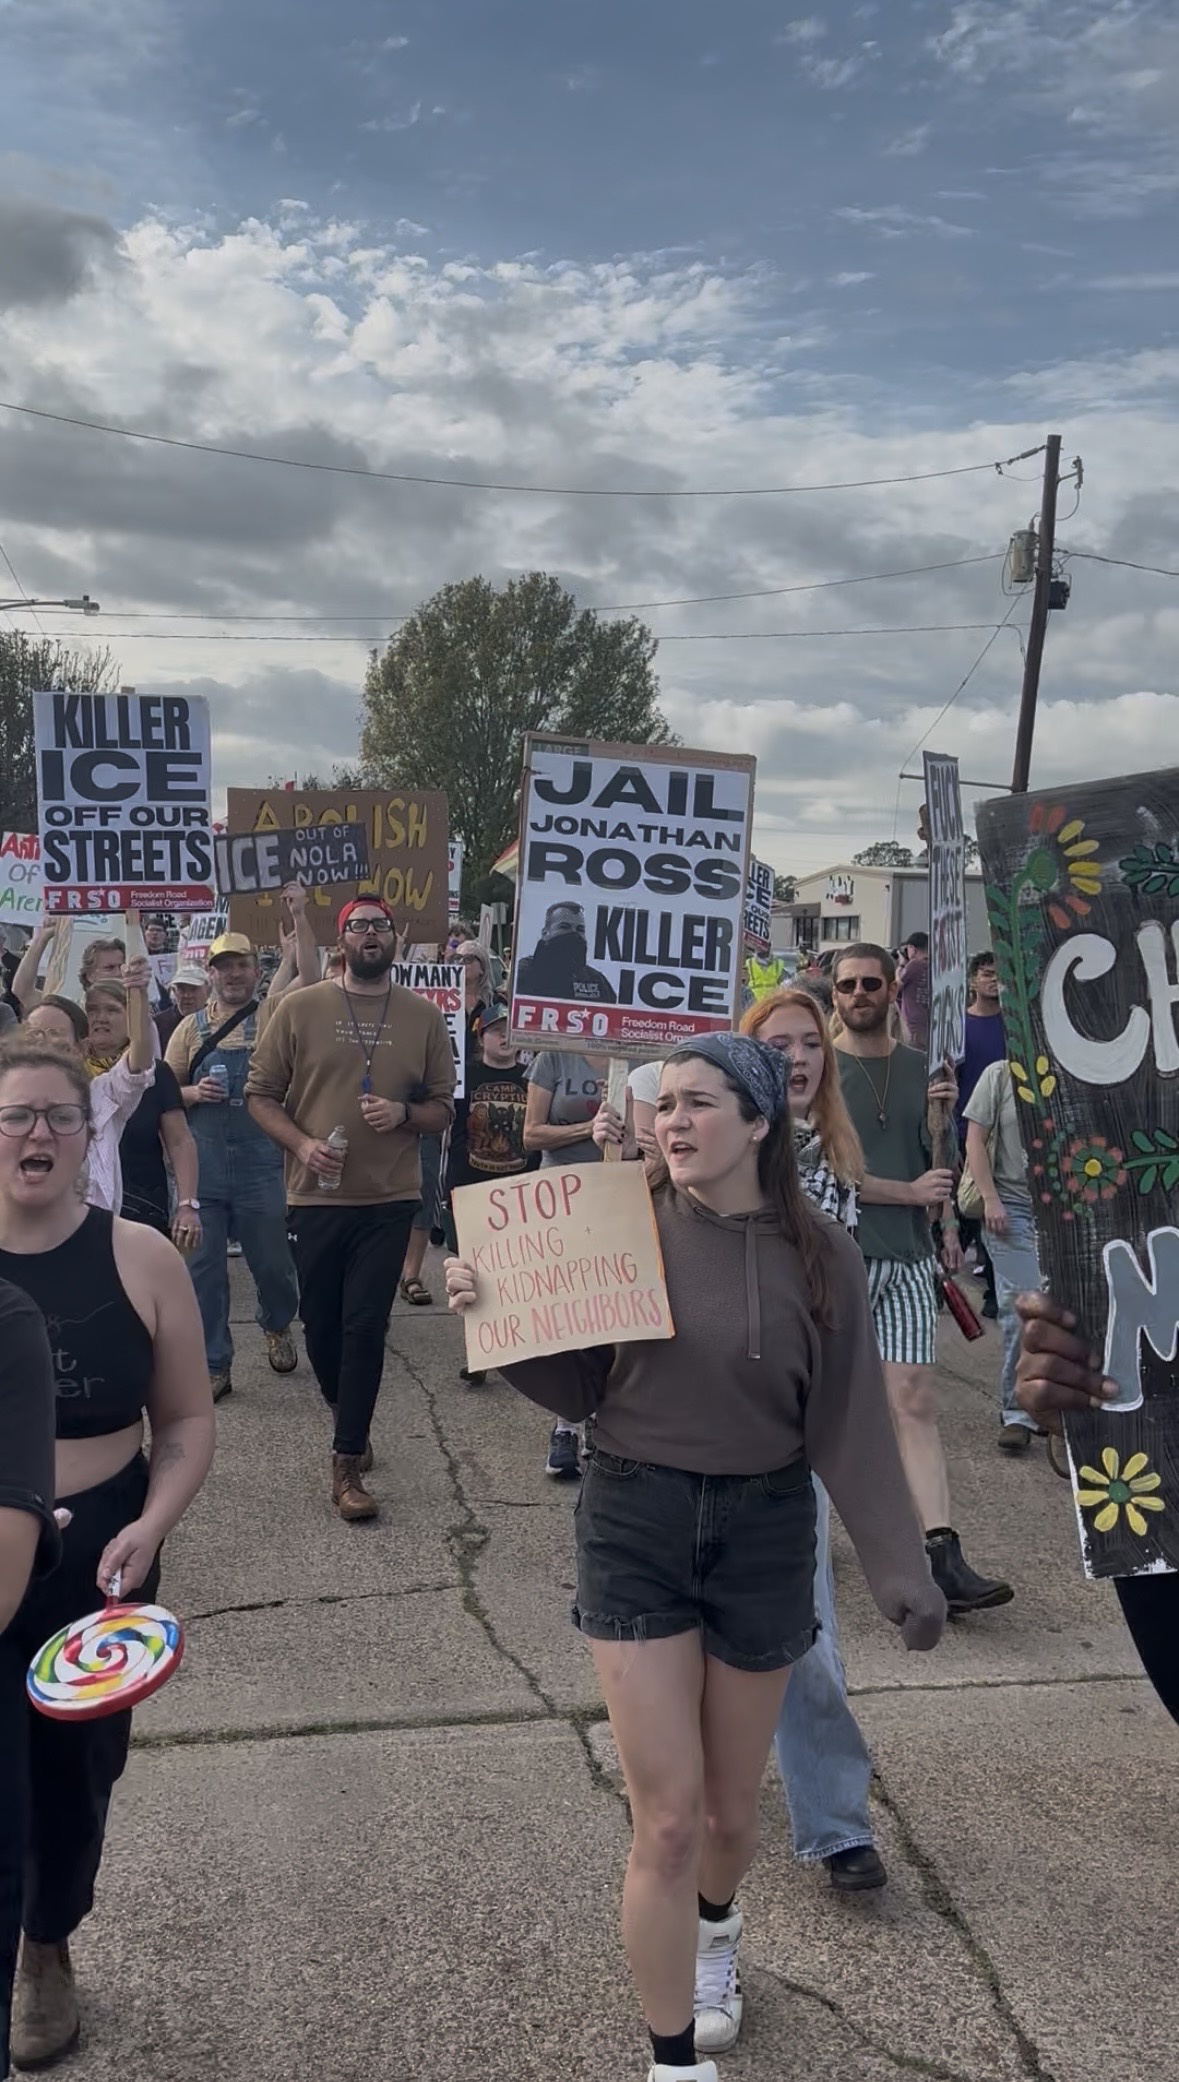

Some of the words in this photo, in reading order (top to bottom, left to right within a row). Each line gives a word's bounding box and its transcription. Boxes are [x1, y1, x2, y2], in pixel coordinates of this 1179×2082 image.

[53, 694, 191, 750] KILLER
[41, 750, 207, 802] ICE
[533, 761, 745, 822] JAIL
[45, 806, 122, 826] OFF
[129, 806, 209, 827] OUR
[295, 828, 326, 841] OUT
[333, 827, 350, 839] OF
[530, 814, 742, 852] JONATHAN
[43, 829, 212, 882] STREETS
[214, 834, 283, 894] ICE
[289, 842, 357, 869] NOLA
[527, 841, 742, 900] ROSS
[48, 889, 121, 910] FRSO
[130, 890, 165, 898] Freedom
[166, 890, 187, 898] Road
[130, 899, 163, 907] Socialist
[594, 904, 734, 973] KILLER
[414, 965, 463, 988] MANY
[618, 969, 730, 1015] ICE
[517, 1005, 609, 1036] FRSO
[620, 1028, 663, 1043] Socialist
[621, 1016, 667, 1030] Freedom
[669, 1021, 696, 1032] Road
[488, 1174, 581, 1231] STOP
[472, 1226, 564, 1275] KILLING
[497, 1252, 637, 1307] KIDNAPPING
[478, 1314, 526, 1353] OUR
[531, 1288, 662, 1344] NEIGHBORS
